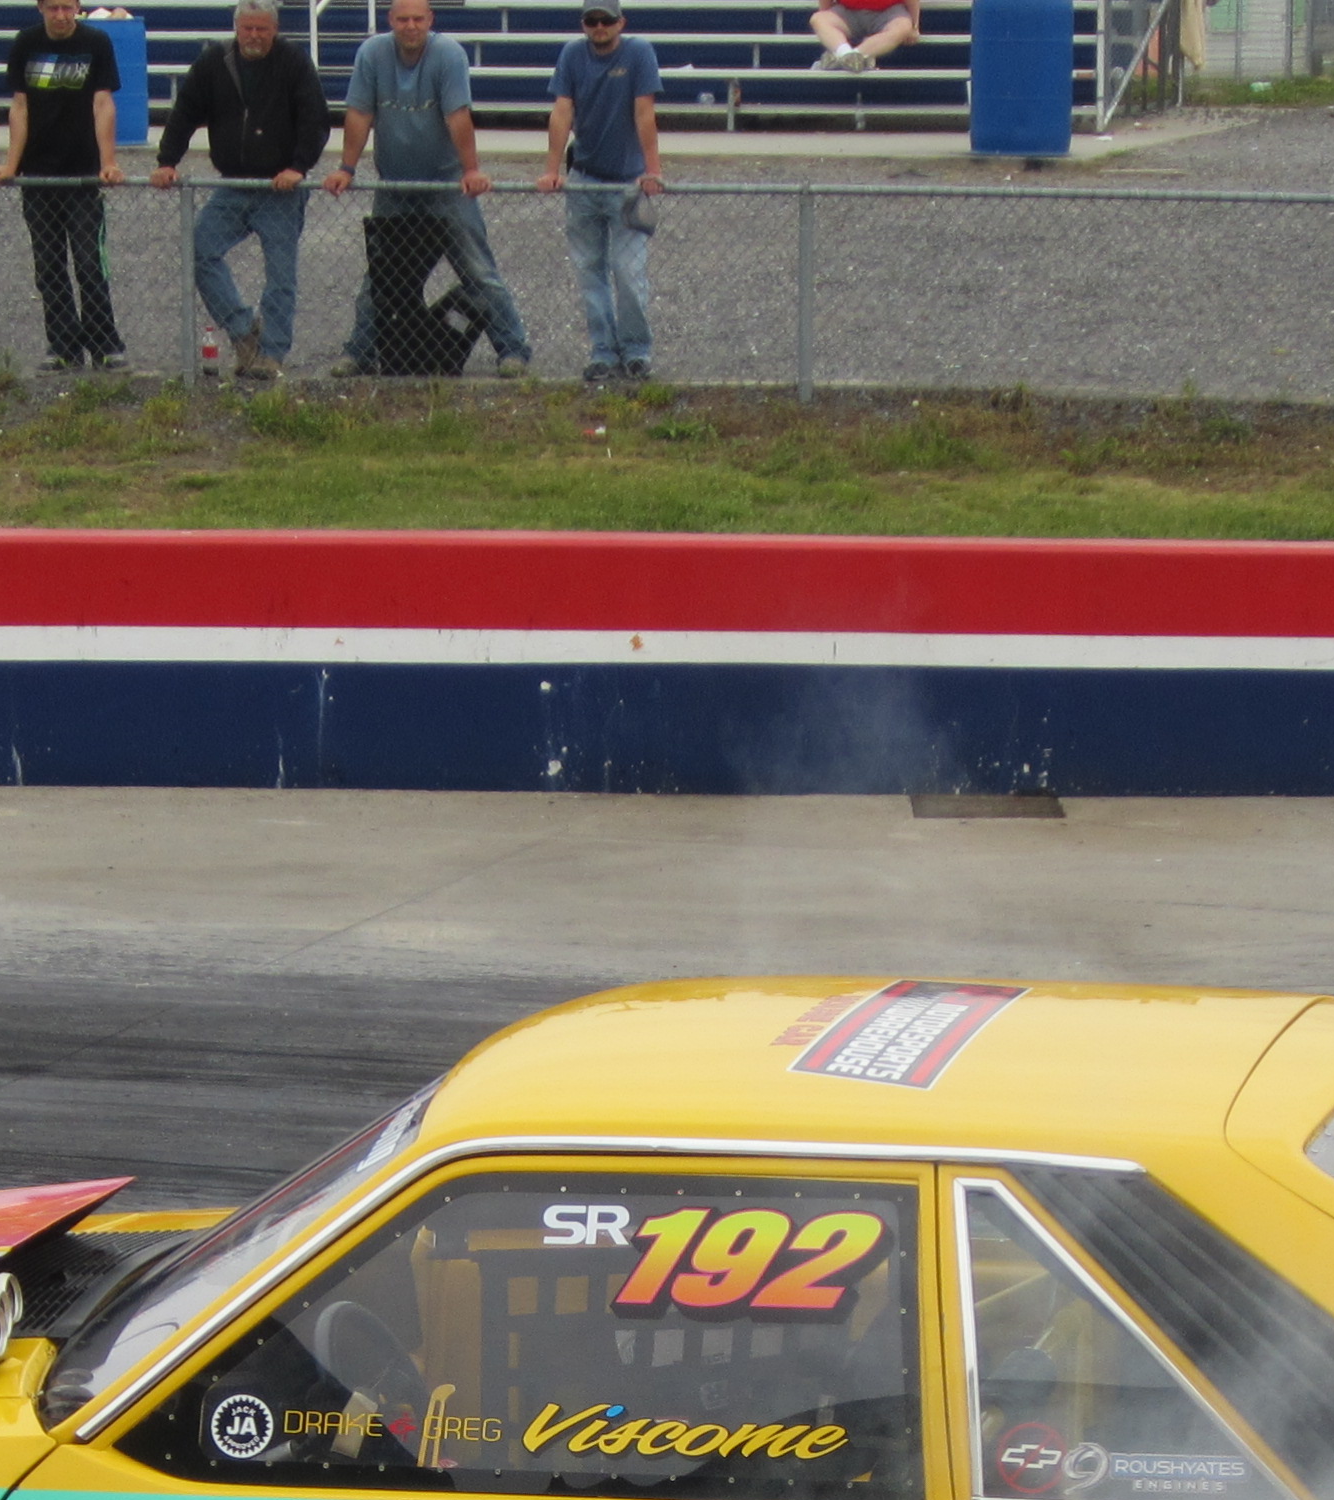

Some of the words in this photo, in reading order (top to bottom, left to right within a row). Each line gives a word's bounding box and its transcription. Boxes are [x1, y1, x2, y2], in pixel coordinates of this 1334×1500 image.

[825, 1004, 924, 1076] WAREHOUSE
[865, 1002, 971, 1081] MOTORSPORTS
[542, 1204, 631, 1246] SR
[613, 1206, 886, 1312] 192
[226, 1416, 257, 1435] JA
[231, 1405, 256, 1417] JACK
[283, 1409, 384, 1437] DRAKE
[423, 1416, 503, 1442] GREG
[522, 1402, 849, 1460] Viscome
[1114, 1458, 1246, 1477] ROUSHYATES
[1134, 1478, 1225, 1491] ENGINES
